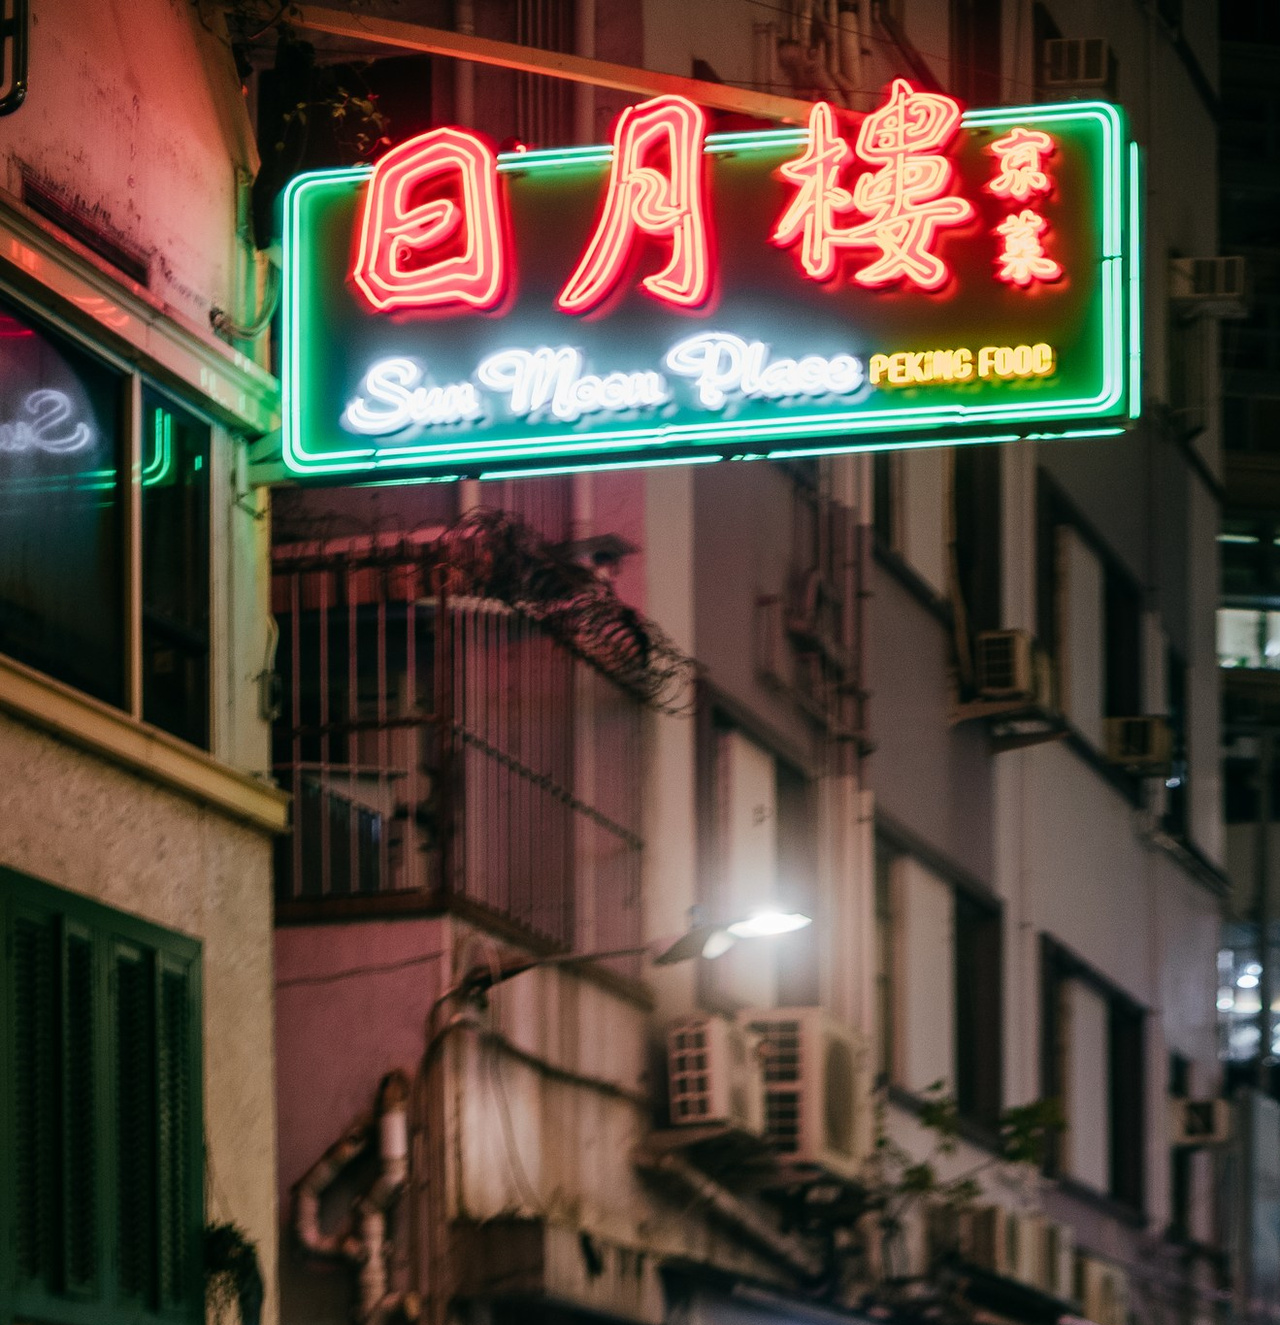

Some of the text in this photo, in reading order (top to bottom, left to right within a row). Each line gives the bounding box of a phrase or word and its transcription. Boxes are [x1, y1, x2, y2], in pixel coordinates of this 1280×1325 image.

[353, 78, 970, 312] 日月樓
[347, 333, 864, 435] Sun Moon Place
[869, 343, 1054, 385] PEKING FOOD
